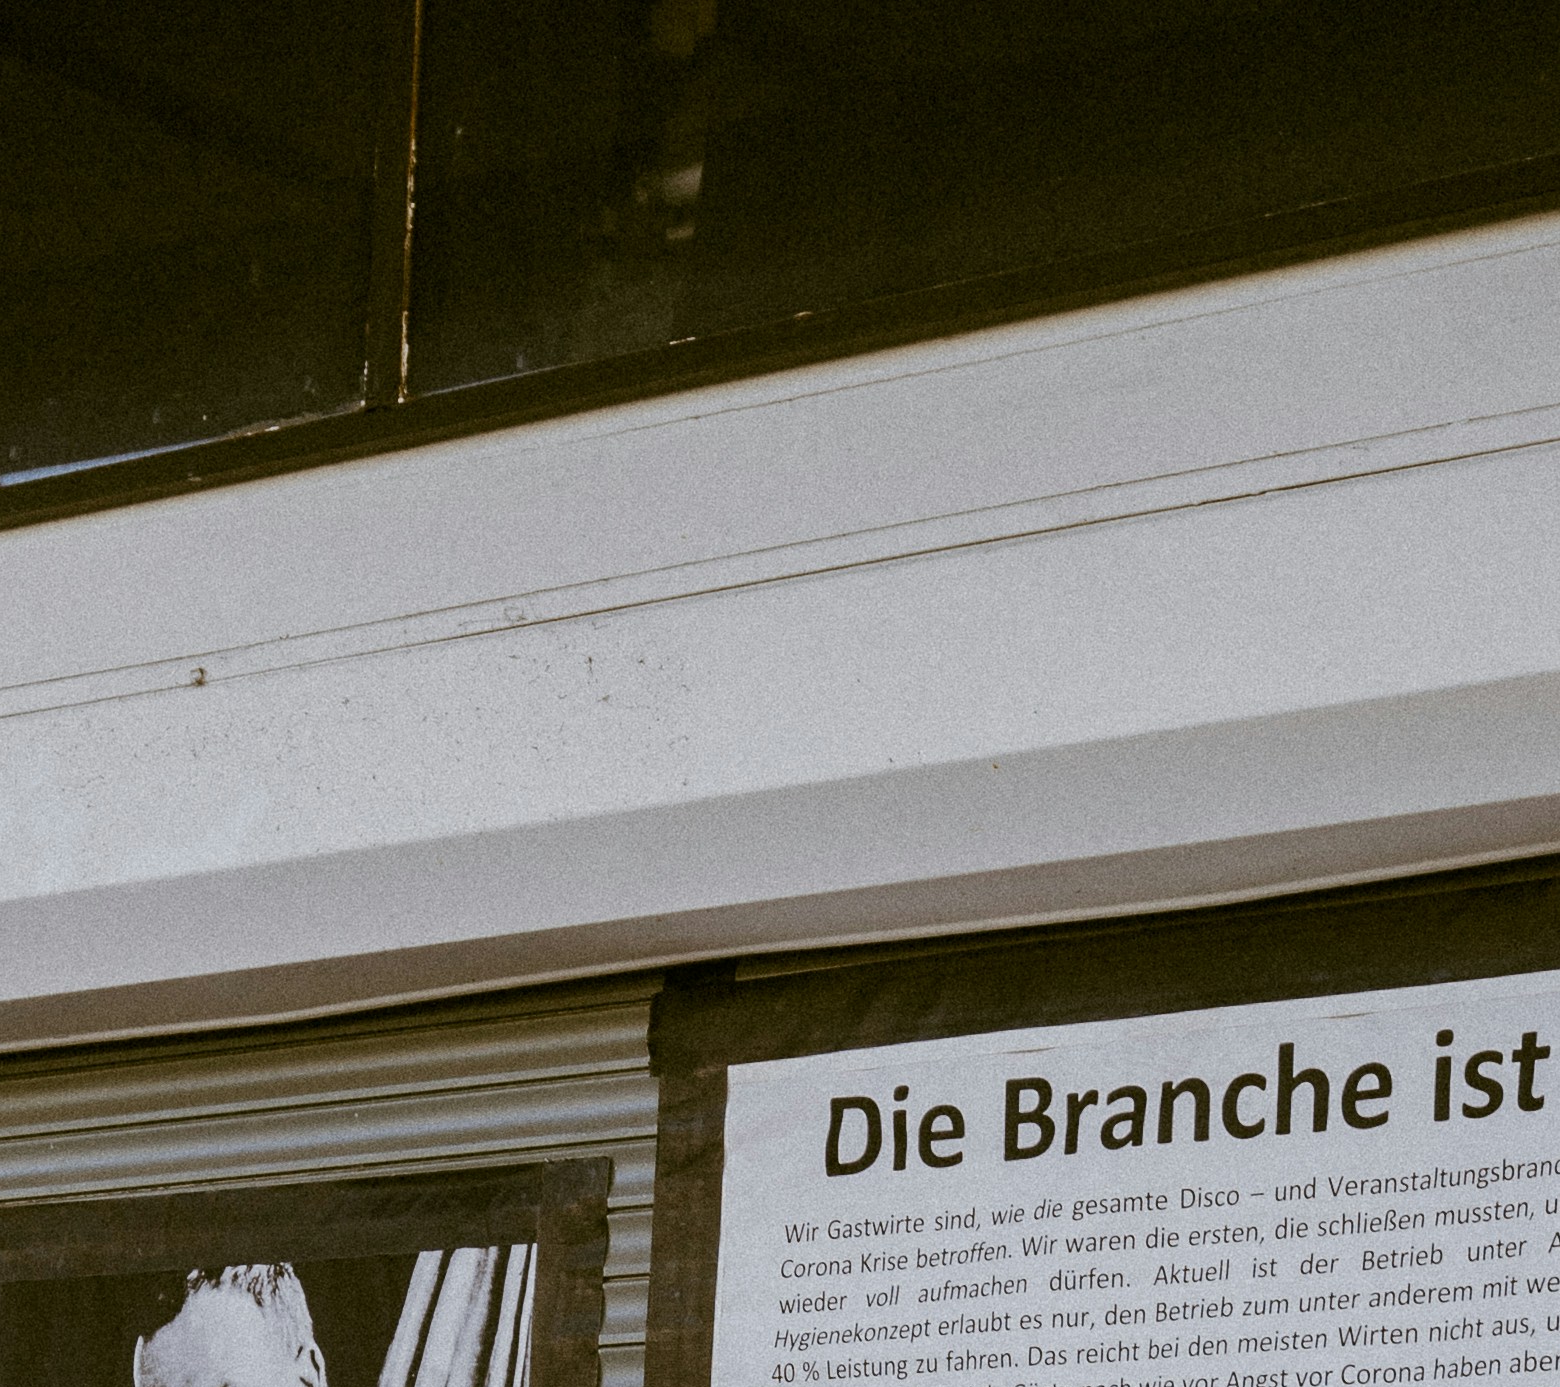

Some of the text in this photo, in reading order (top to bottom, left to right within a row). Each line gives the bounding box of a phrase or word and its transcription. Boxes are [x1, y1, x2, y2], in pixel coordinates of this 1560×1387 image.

[824, 1085, 966, 1178] Die
[1003, 1042, 1394, 1162] Branche
[1433, 1029, 1551, 1123] ist
